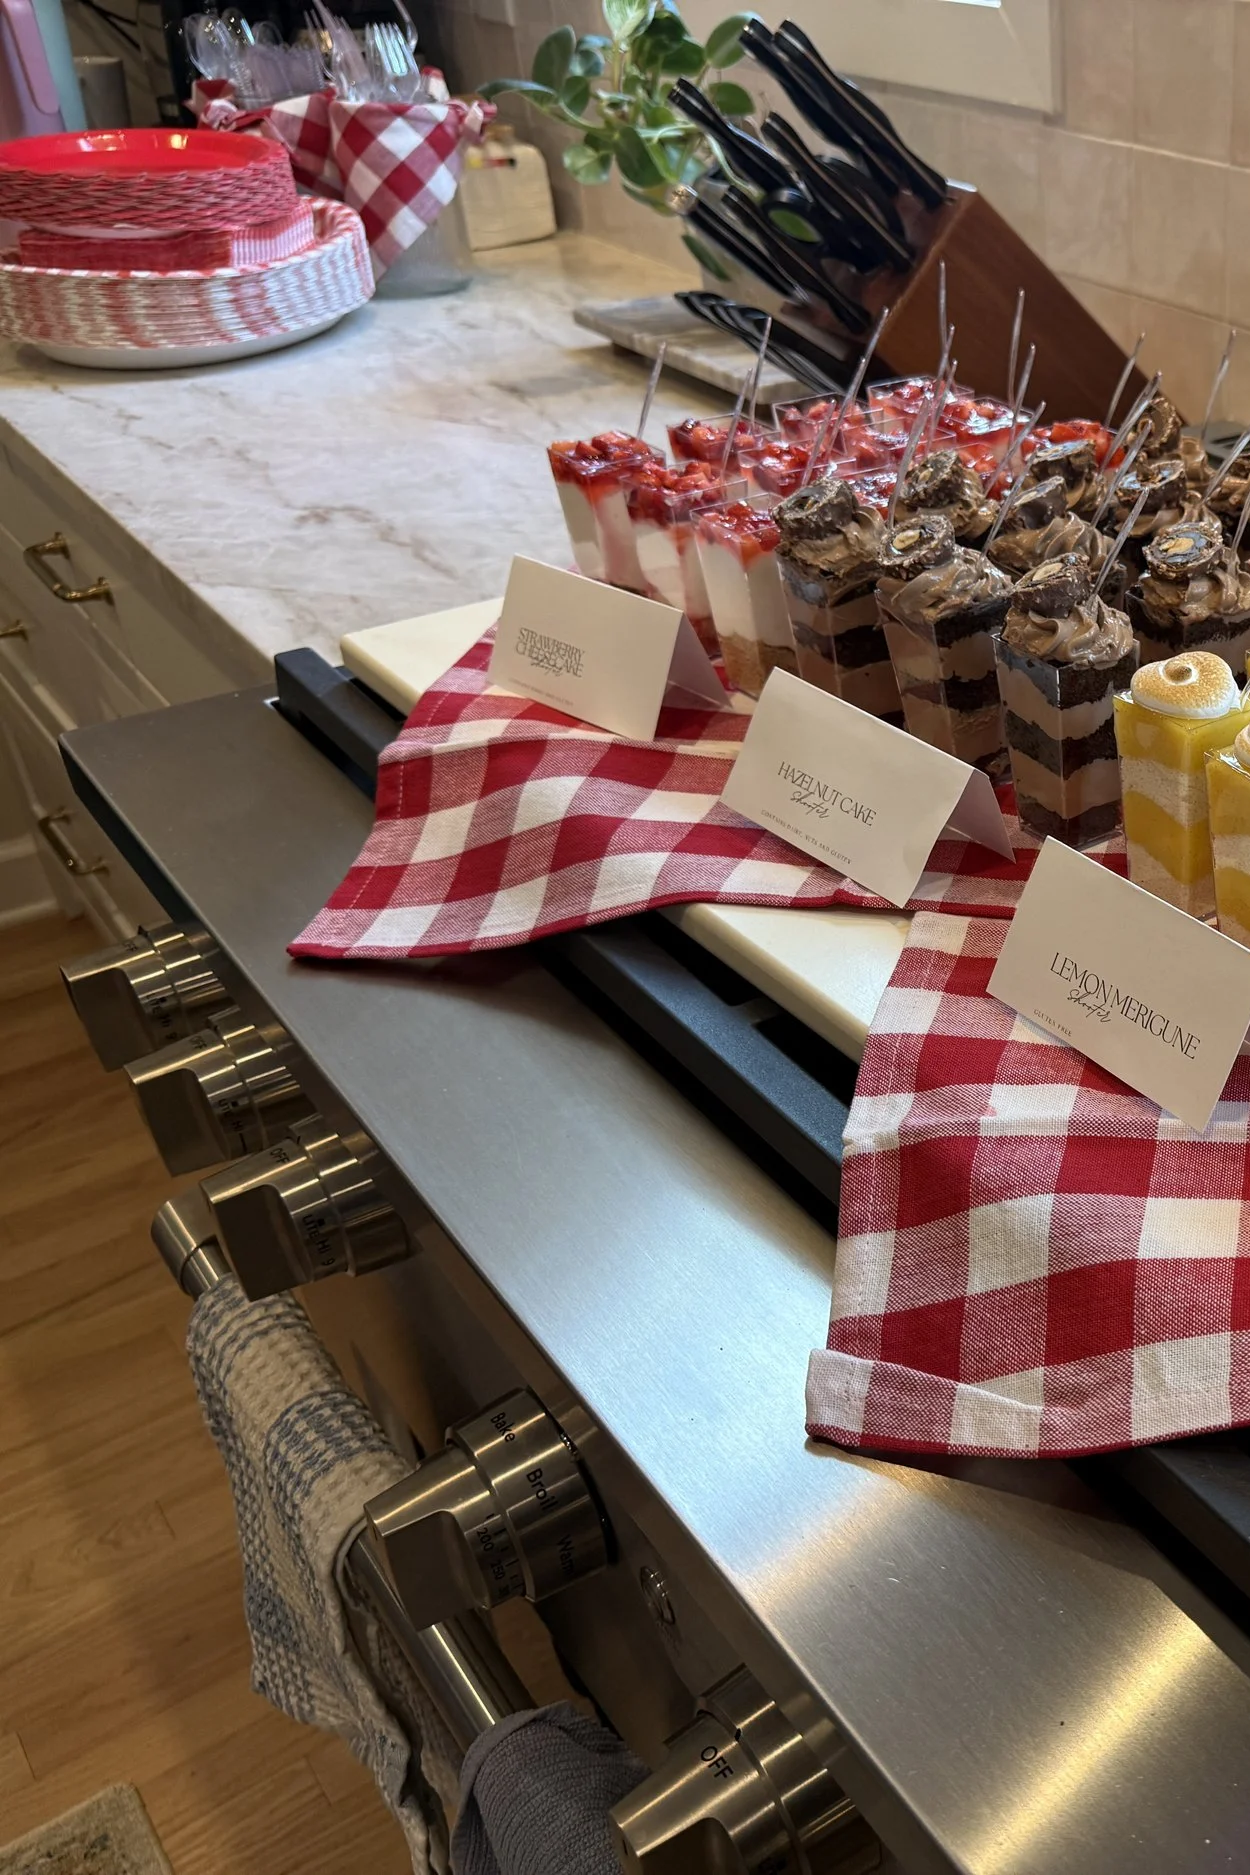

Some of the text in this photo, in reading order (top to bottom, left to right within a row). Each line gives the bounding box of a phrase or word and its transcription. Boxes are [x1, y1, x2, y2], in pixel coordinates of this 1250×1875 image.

[515, 642, 584, 678] CHEESECAKE
[518, 627, 585, 661] STRAWBERRY
[777, 761, 877, 827] HAZELNUT CAKE
[1033, 1008, 1073, 1038] GLUTEN FREE
[1049, 952, 1202, 1060] LEMON MERIGUNE
[270, 1147, 290, 1163] OFF
[490, 1411, 516, 1443] Bake
[526, 1467, 559, 1511] Broil
[476, 1527, 494, 1553] 200
[699, 1745, 734, 1780] OFF
